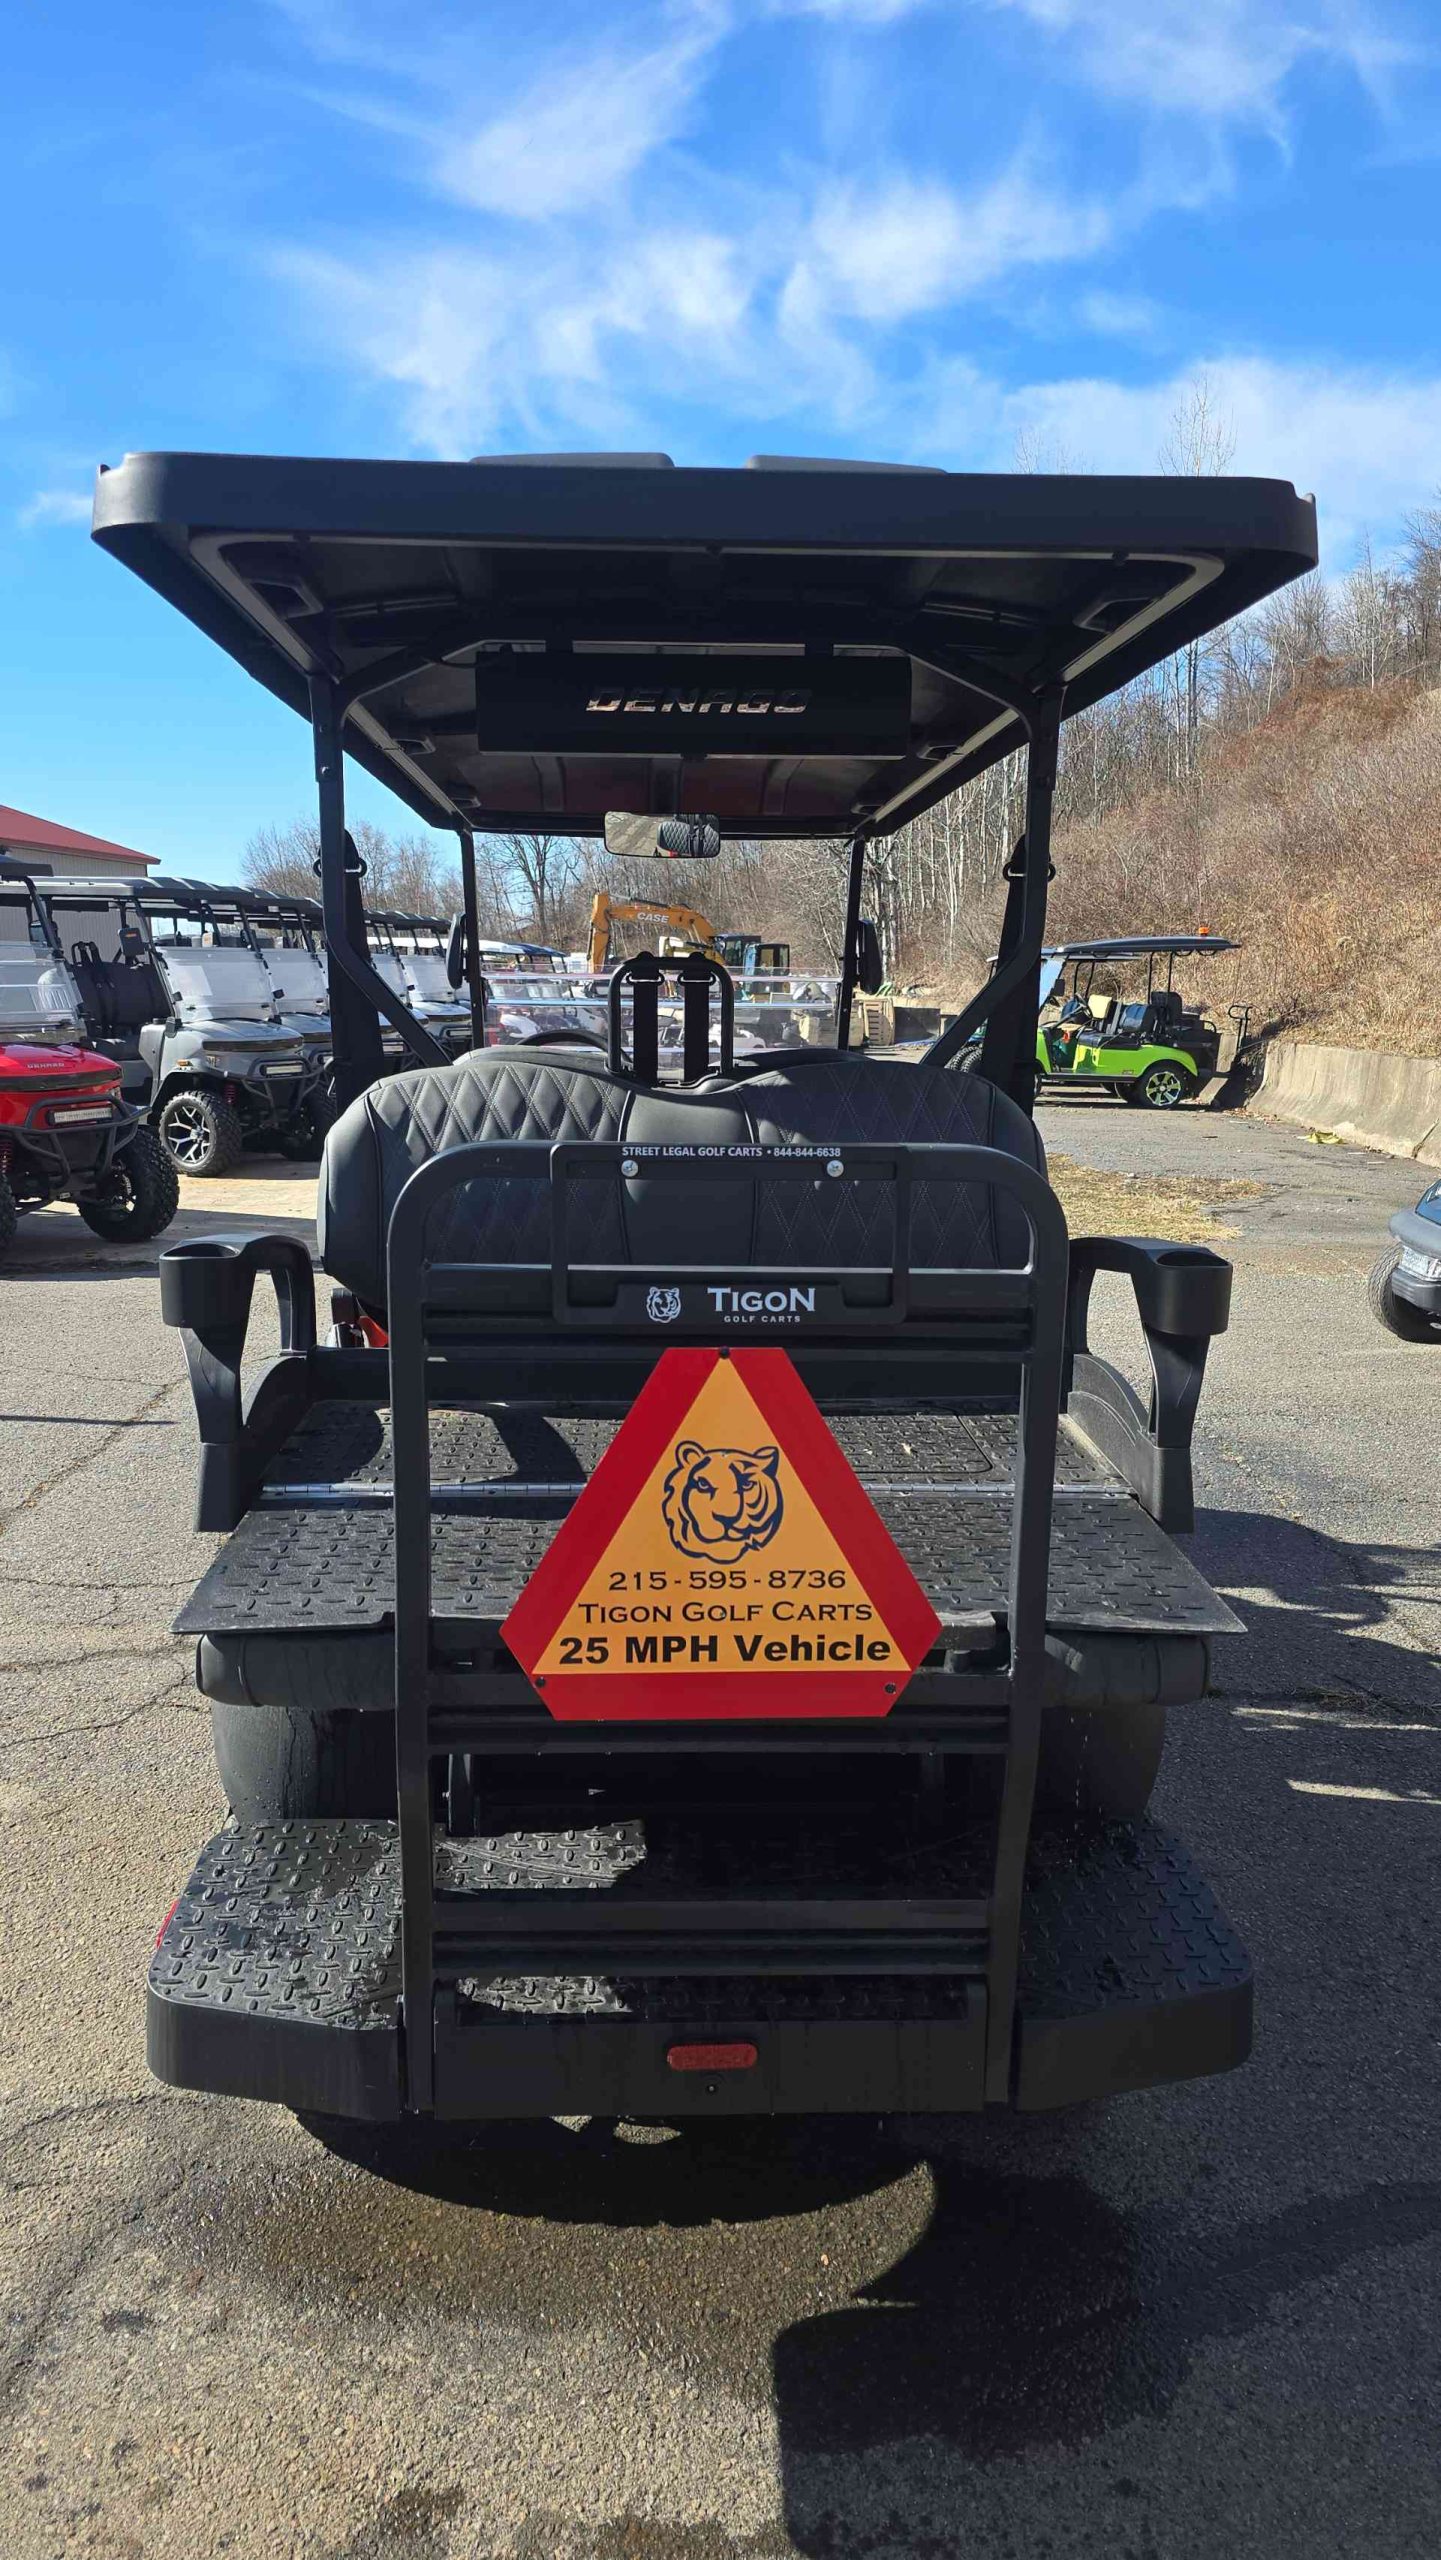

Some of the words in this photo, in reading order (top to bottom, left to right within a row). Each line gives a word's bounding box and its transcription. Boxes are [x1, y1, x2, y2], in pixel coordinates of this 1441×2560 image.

[586, 688, 812, 714] DENAGO
[637, 912, 669, 923] CASE
[621, 1146, 660, 1156] STREET
[662, 1146, 696, 1157] LEGAL
[698, 1146, 726, 1157] GOLF
[727, 1147, 763, 1157] CARTS
[773, 1147, 841, 1157] 844-844-6638
[707, 1287, 816, 1312] TIGON
[723, 1315, 756, 1323] GOLF
[761, 1315, 801, 1323] CARTS
[578, 1603, 672, 1624] TIGON
[681, 1602, 764, 1623] GOLF
[771, 1601, 873, 1622] CARTS
[558, 1637, 609, 1665] 25
[625, 1635, 719, 1664] MPH
[733, 1634, 892, 1662] Vehicle
